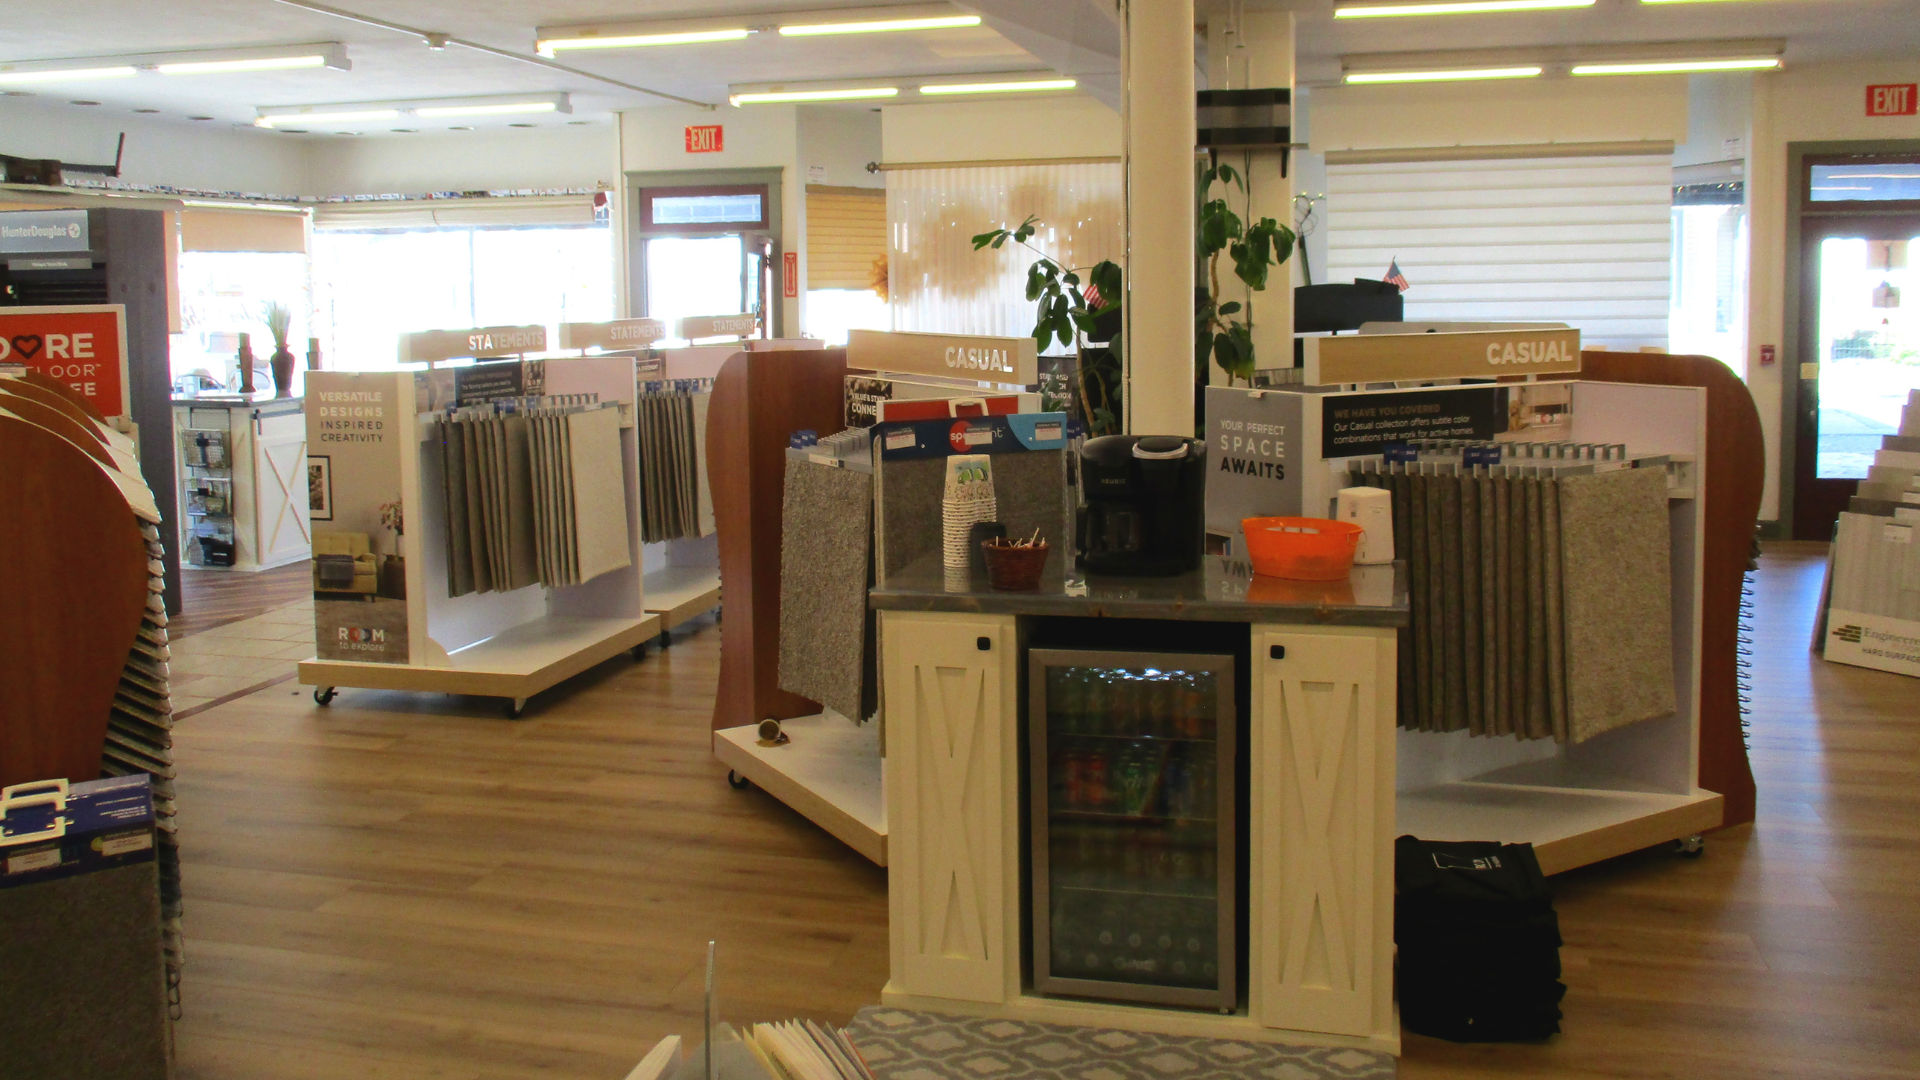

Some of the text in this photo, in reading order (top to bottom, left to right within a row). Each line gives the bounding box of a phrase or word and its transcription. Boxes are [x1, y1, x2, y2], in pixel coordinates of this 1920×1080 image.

[1874, 87, 1910, 113] EXIT
[691, 127, 717, 150] EXIT
[610, 324, 665, 340] STATEMENTS
[712, 318, 753, 332] STATEMENTS
[468, 331, 544, 351] STATEMENTS
[945, 346, 1013, 373] CASUAL
[1486, 340, 1573, 365] CASUAL
[319, 391, 382, 402] VERSATILE
[320, 406, 383, 417] DESIGNS
[851, 402, 877, 416] CONNE
[1334, 404, 1441, 419] WE HAVE YOU COVERED
[320, 420, 383, 430] INSPIRED
[1221, 420, 1285, 436] YOUR PERFECT
[1333, 415, 1471, 432] Our Casual collection offers subtle color
[321, 433, 384, 442] CREATIVITY
[1333, 433, 1381, 444] combinations
[1383, 432, 1398, 441] that
[1399, 431, 1416, 440] work
[1418, 429, 1428, 438] for
[1430, 428, 1450, 437] active
[1221, 434, 1285, 457] SPACE
[1221, 456, 1285, 480] AWAITS
